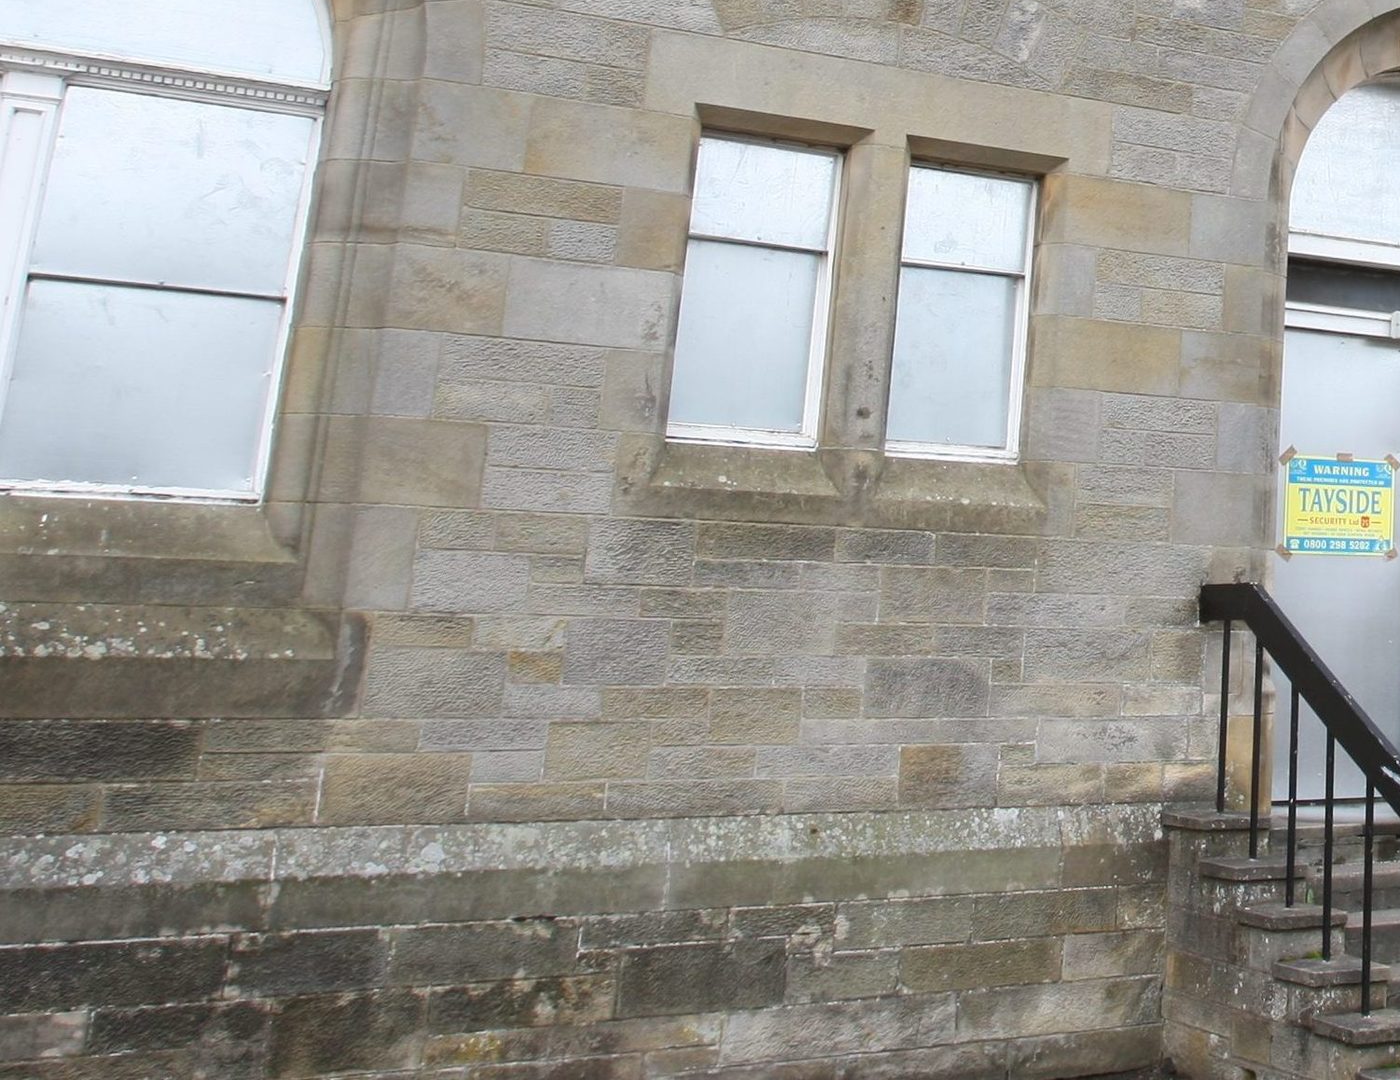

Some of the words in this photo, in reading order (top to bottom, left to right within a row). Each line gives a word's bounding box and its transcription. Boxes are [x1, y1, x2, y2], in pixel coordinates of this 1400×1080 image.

[1313, 465, 1369, 477] WARNING
[1298, 488, 1382, 514] TAYSIDE
[1309, 517, 1347, 525] SECURITY
[1303, 539, 1327, 549] 0800
